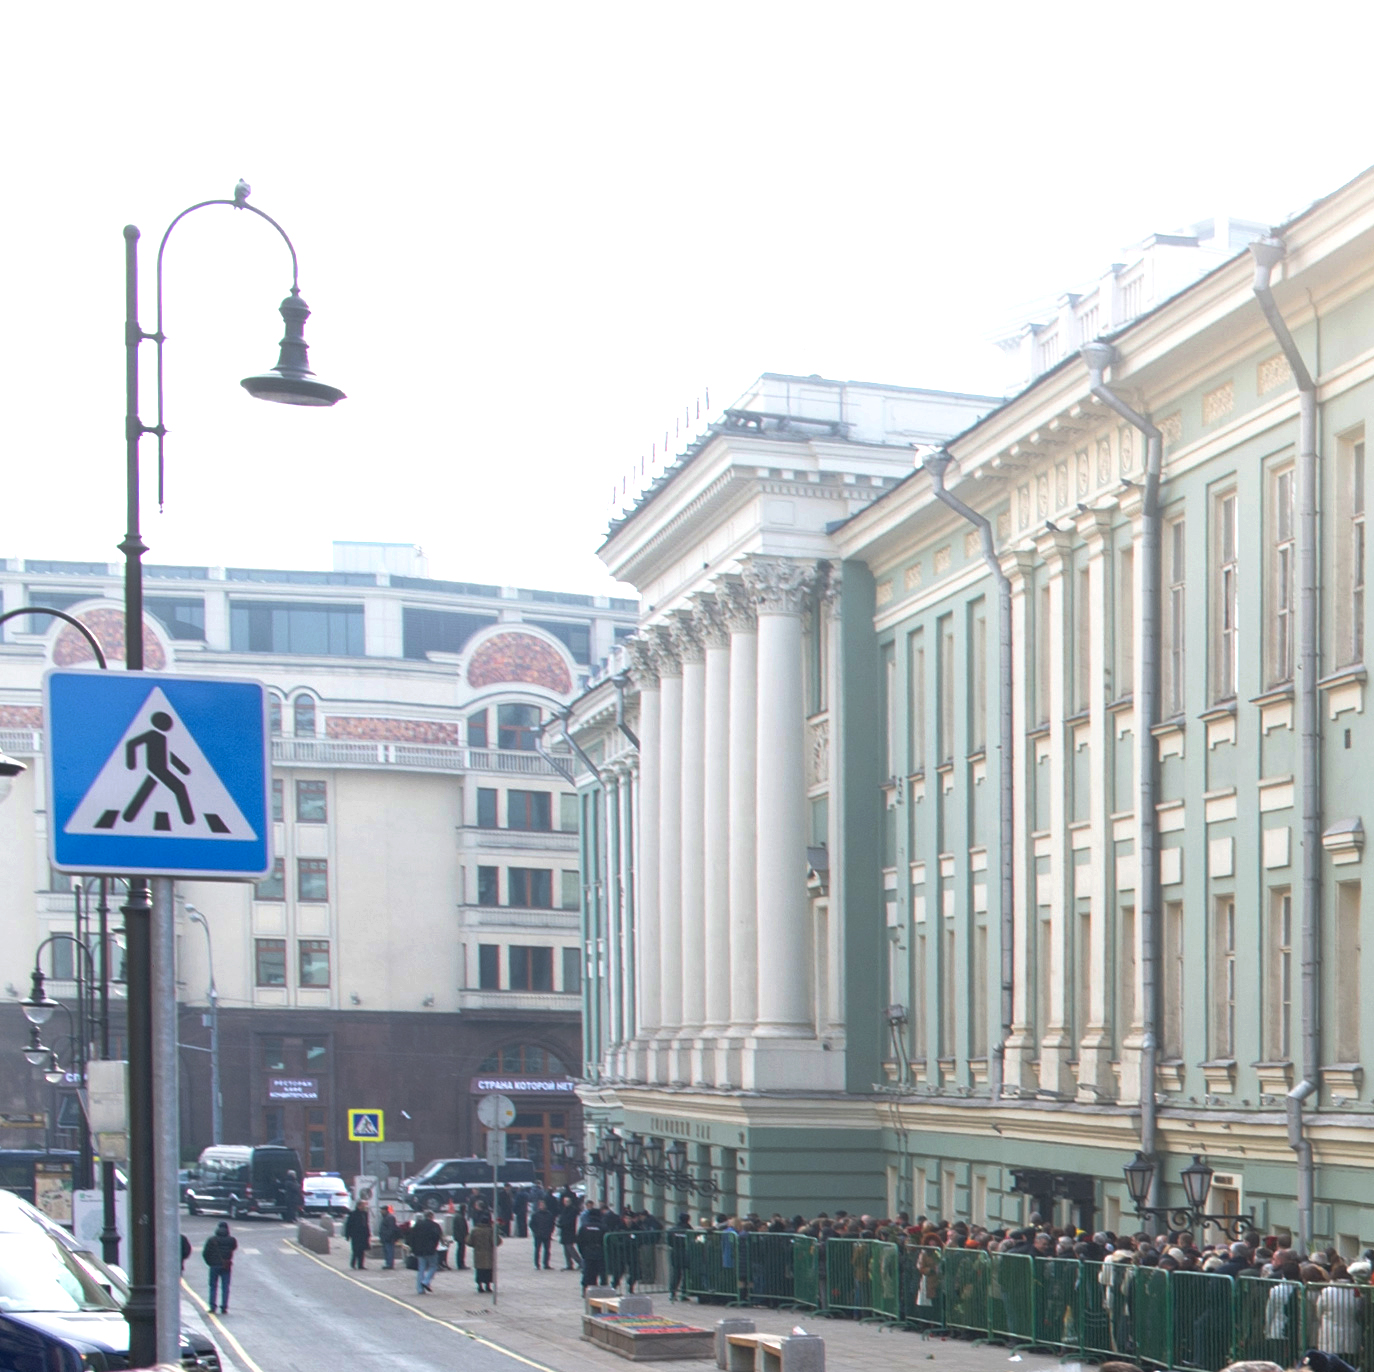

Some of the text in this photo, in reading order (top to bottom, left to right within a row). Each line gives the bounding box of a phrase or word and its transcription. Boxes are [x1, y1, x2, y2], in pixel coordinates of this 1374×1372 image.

[478, 1080, 574, 1091] СТРАНА КОТОРОЙ НЕТ
